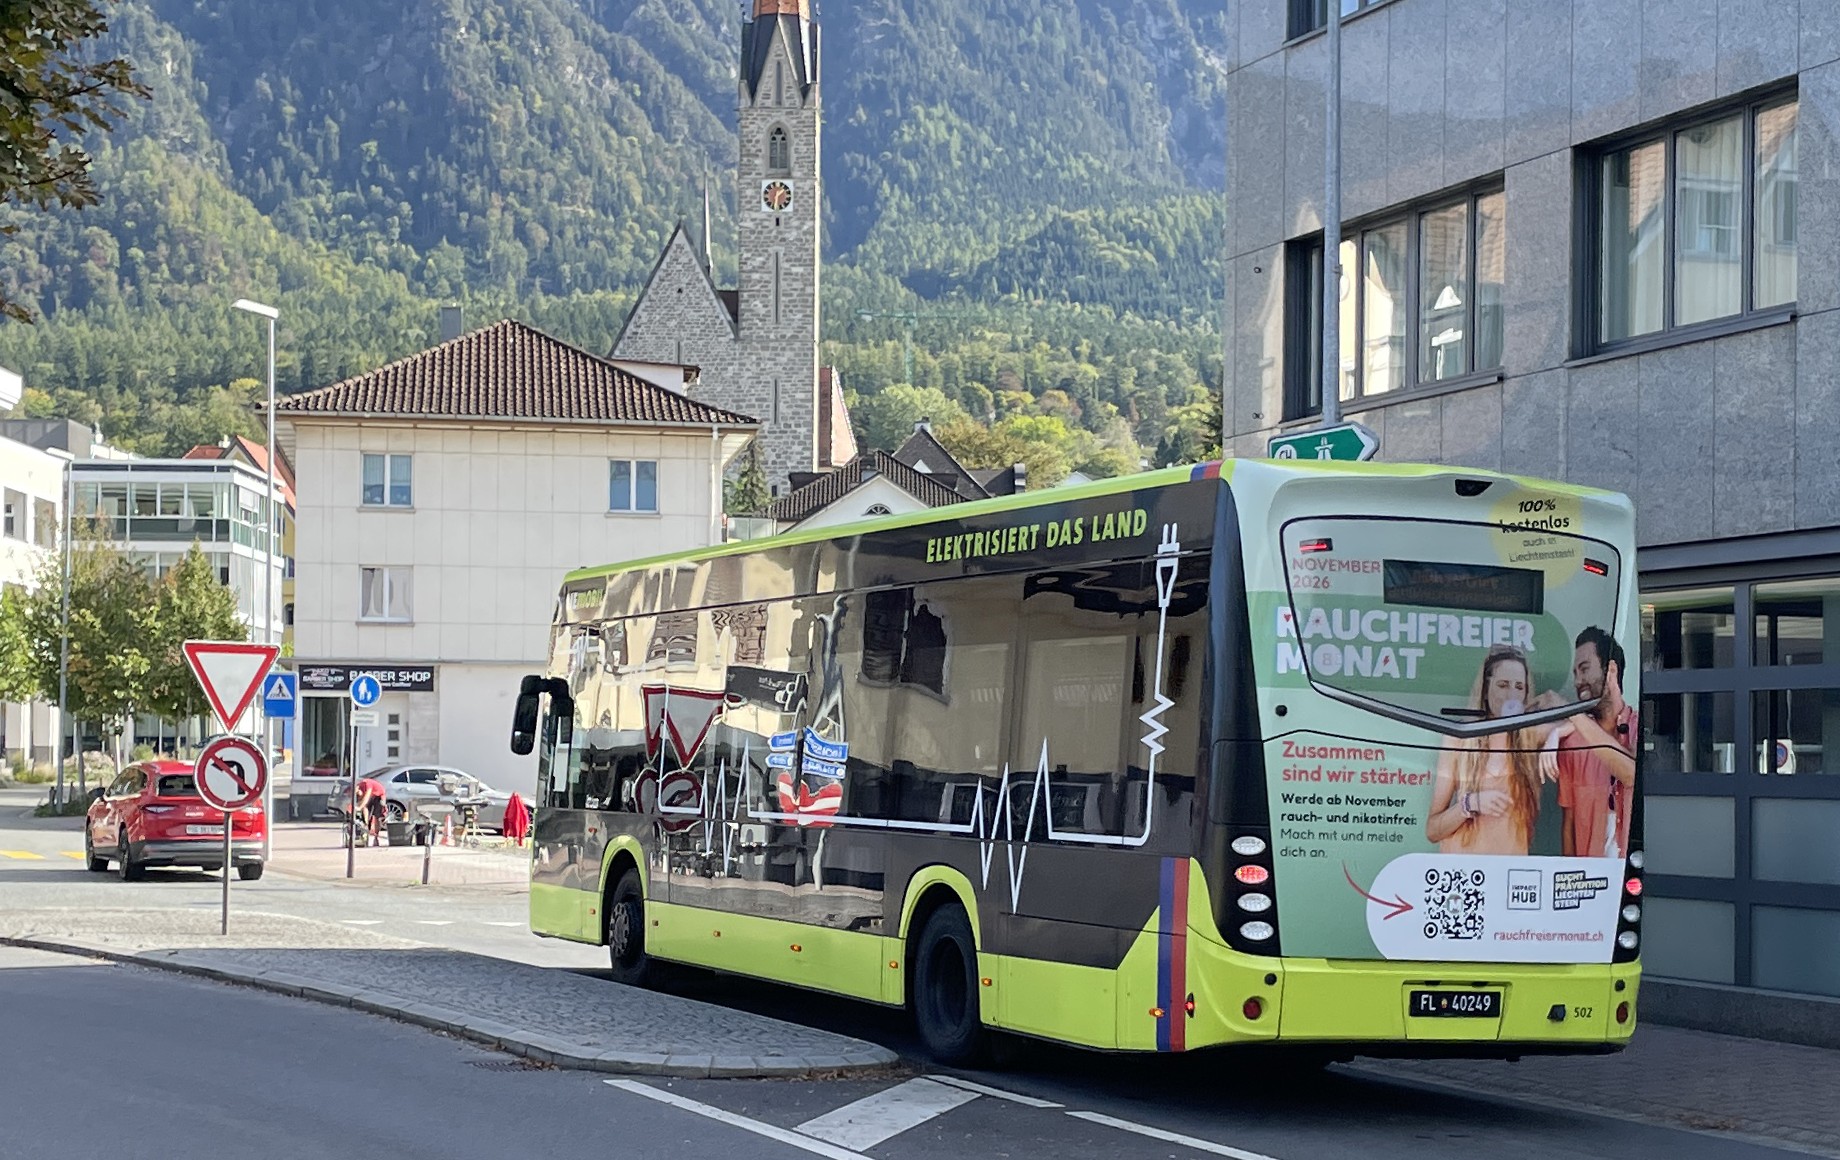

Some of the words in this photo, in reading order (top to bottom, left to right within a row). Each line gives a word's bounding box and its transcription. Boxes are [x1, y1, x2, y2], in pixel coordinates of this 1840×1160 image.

[1518, 498, 1556, 513] 100%
[926, 524, 1040, 563] ELEKTRISIERT
[1046, 517, 1083, 548] DAS
[1091, 509, 1147, 542] LAND
[1293, 558, 1380, 573] NOVEMBER
[1293, 575, 1330, 589] 2026
[1276, 606, 1535, 652] RAUCHFREIER
[1276, 642, 1425, 679] MONAT
[398, 671, 431, 682] SHOP
[1282, 741, 1385, 761] Zusammen
[1282, 764, 1322, 782] sind
[1326, 765, 1355, 783] wir
[1360, 767, 1431, 786] stärker!
[1281, 793, 1323, 805] Werde
[1326, 794, 1342, 805] ab
[1345, 795, 1406, 807] November
[1281, 811, 1322, 822] rauch-
[1326, 812, 1349, 823] und
[1280, 829, 1314, 840] Mach
[1318, 830, 1337, 840] mit
[1341, 831, 1363, 841] und
[1367, 831, 1403, 842] melde
[1280, 847, 1306, 857] dich
[1512, 892, 1537, 903] HUB
[1493, 929, 1603, 942] rauchfreiermonat.ch
[1420, 994, 1436, 1011] FL
[1452, 995, 1491, 1012] 40249
[1574, 1007, 1592, 1018] 502
